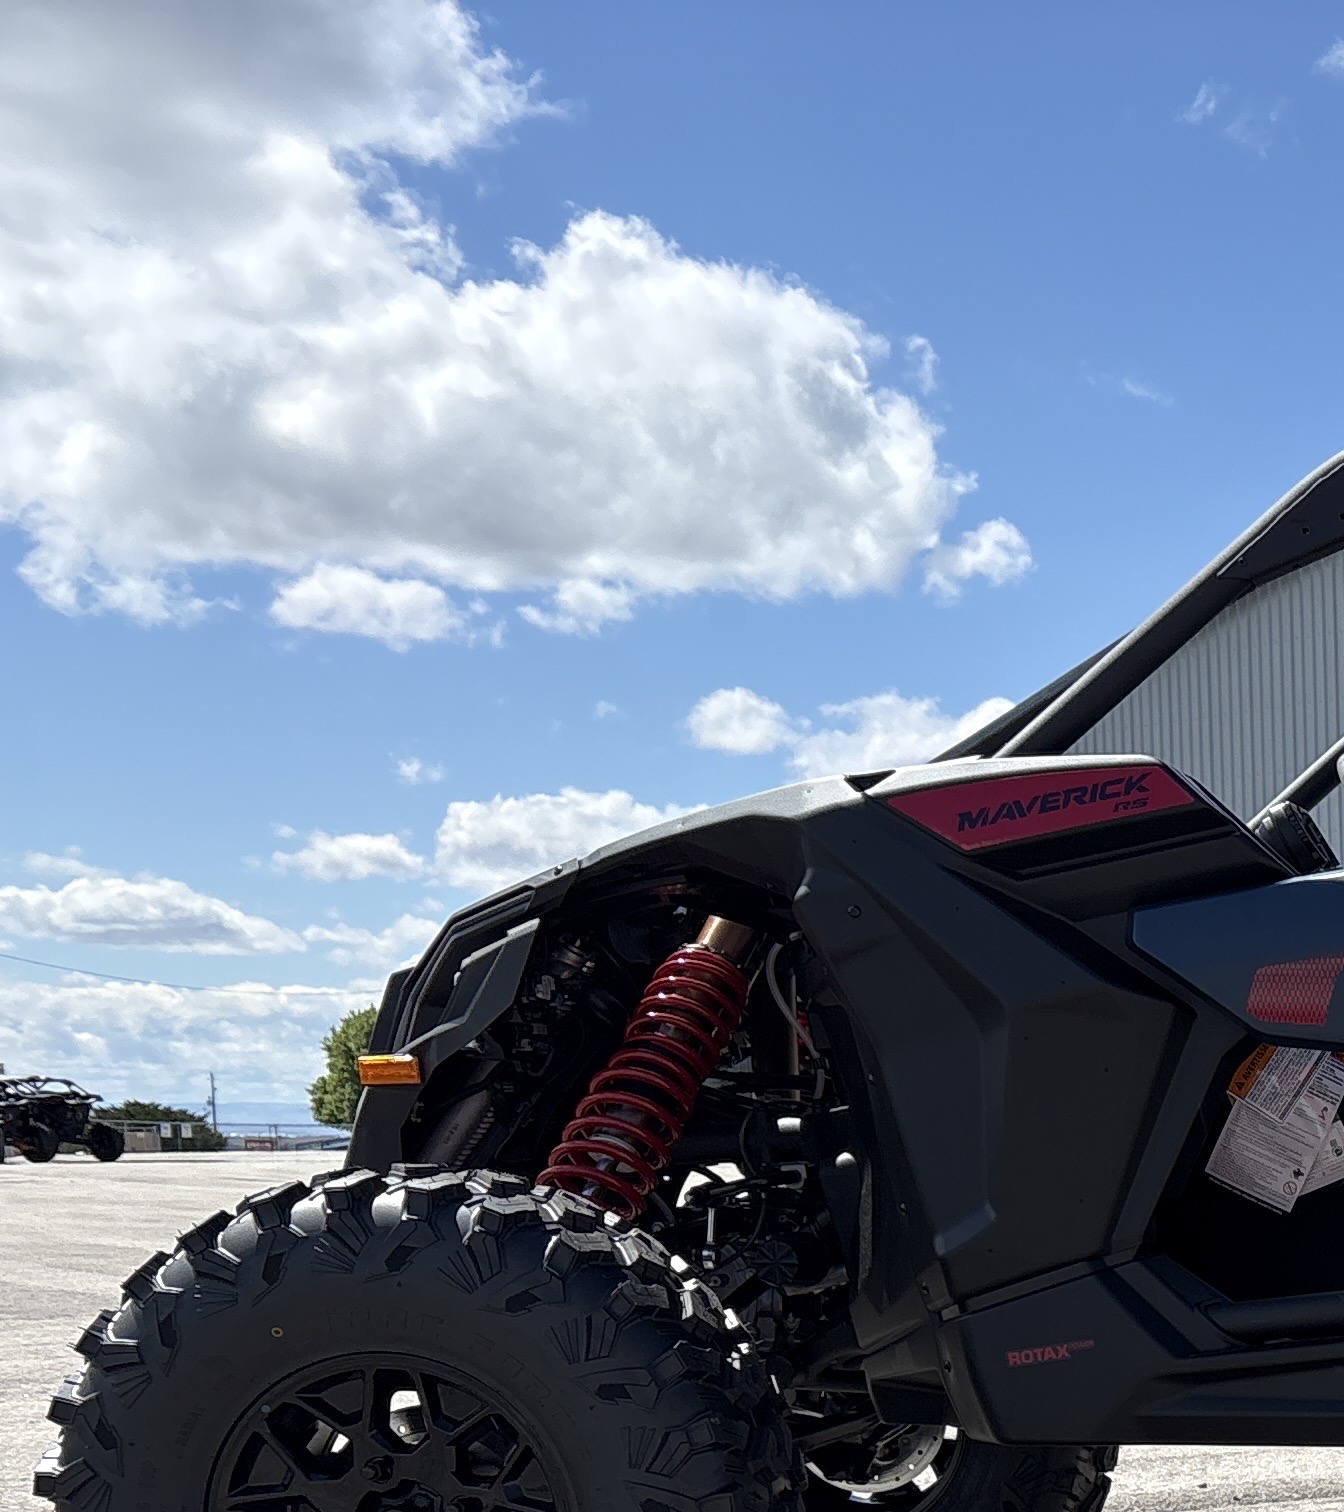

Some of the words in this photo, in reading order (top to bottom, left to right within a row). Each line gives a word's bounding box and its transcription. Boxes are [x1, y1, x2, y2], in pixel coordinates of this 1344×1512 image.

[957, 771, 1152, 832] MAVERICK
[1112, 797, 1149, 813] RS
[1007, 1343, 1071, 1367] ROTAX
